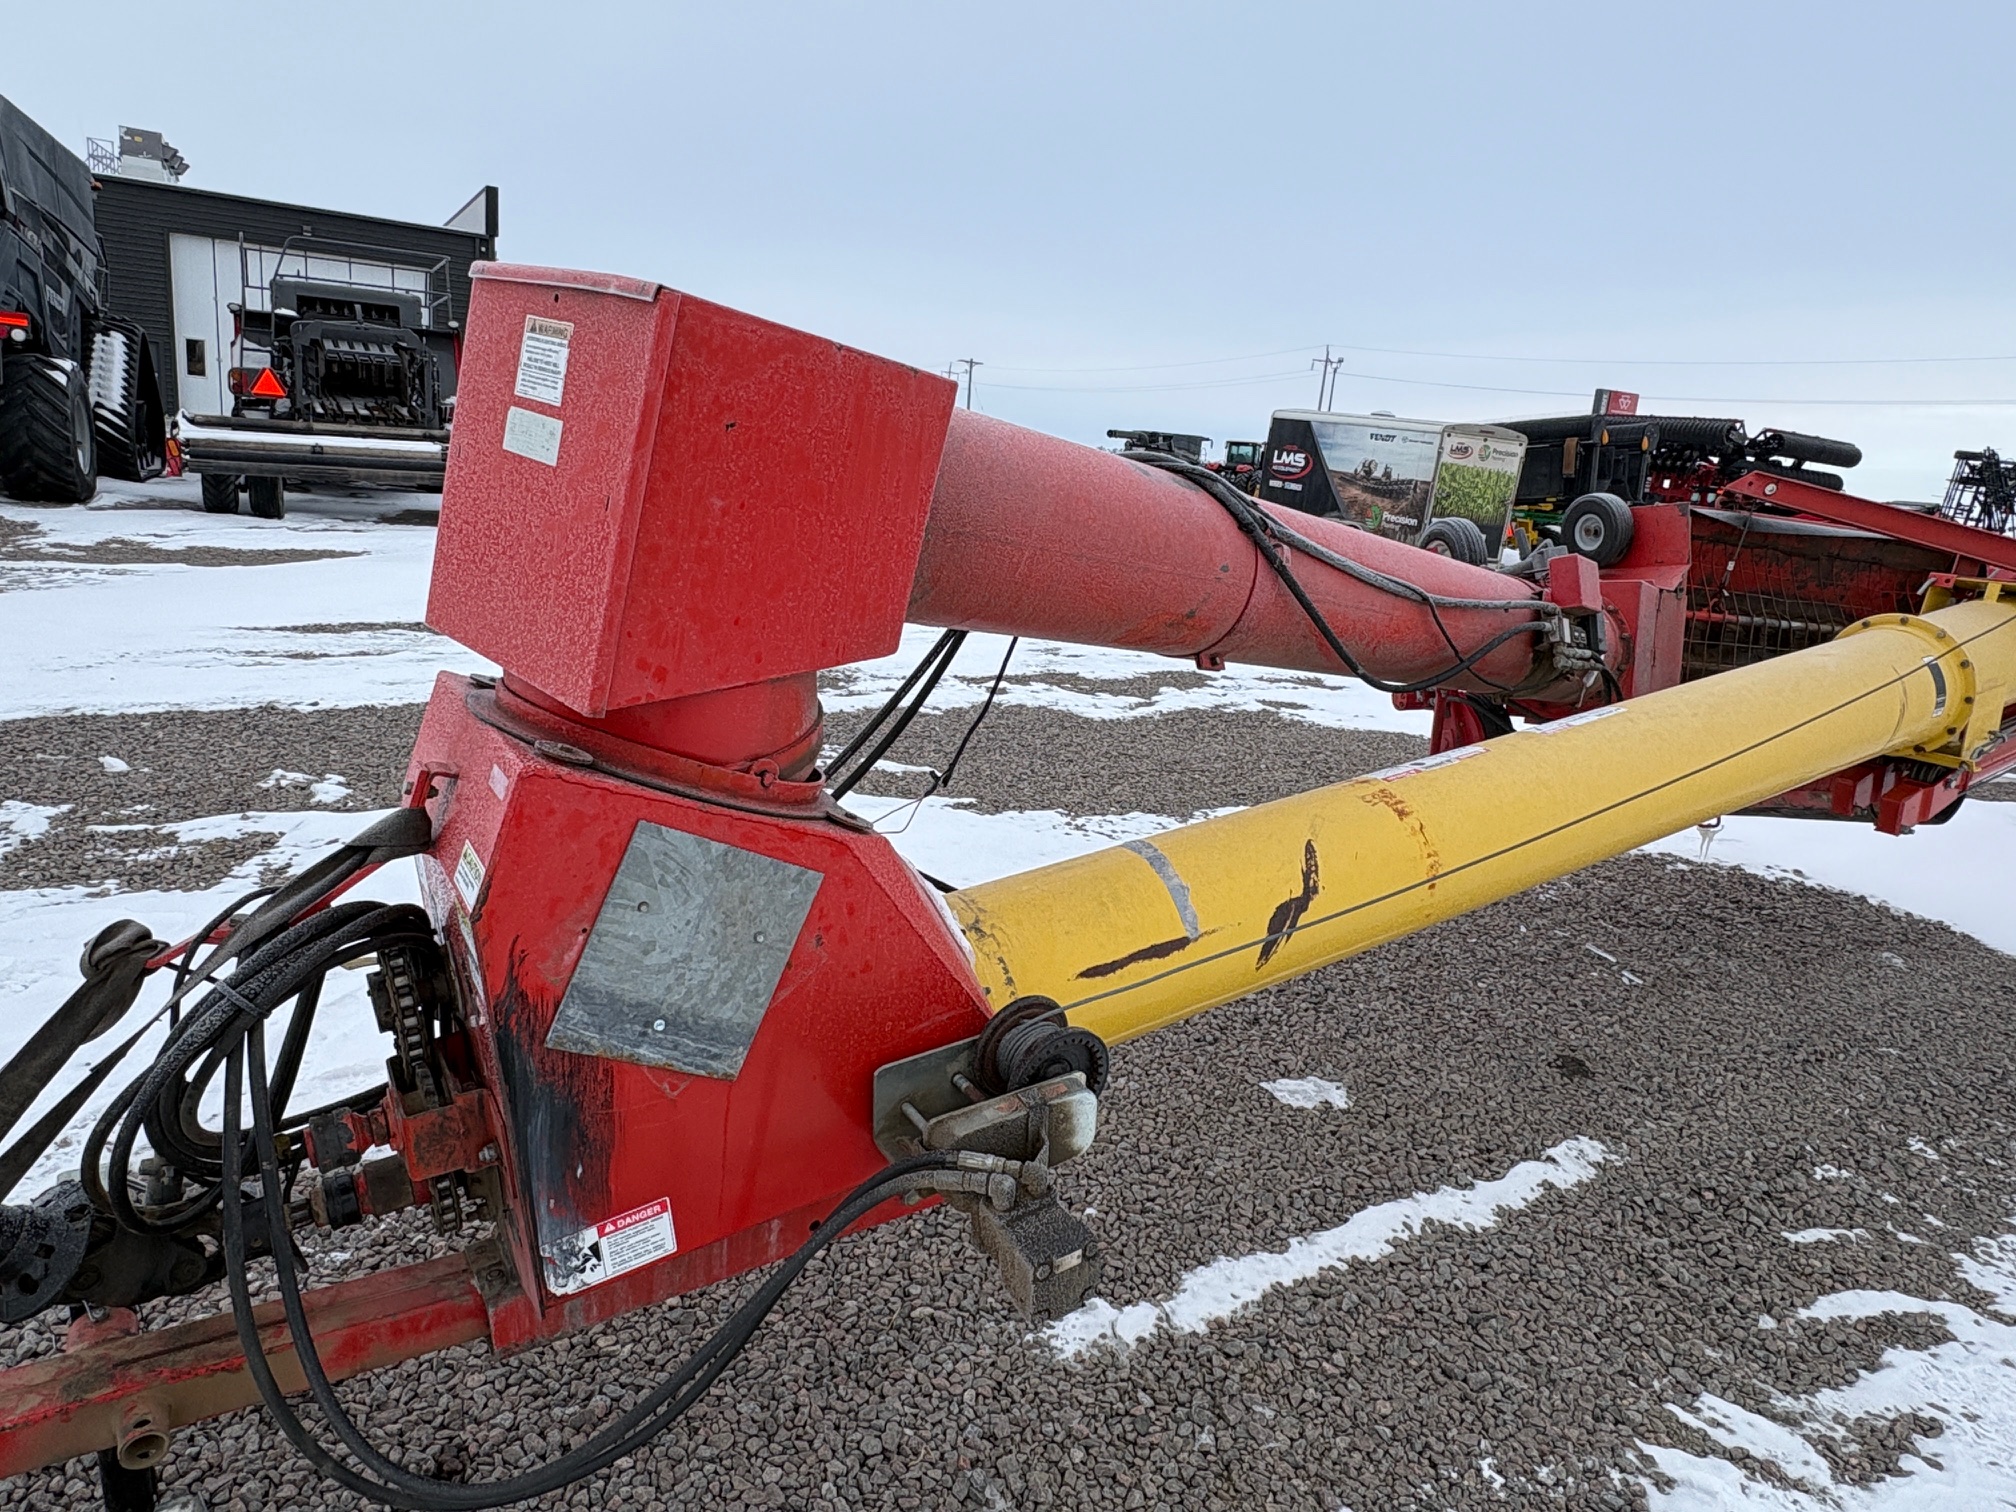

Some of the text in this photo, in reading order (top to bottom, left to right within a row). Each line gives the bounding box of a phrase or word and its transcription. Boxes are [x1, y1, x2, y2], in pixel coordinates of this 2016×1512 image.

[1369, 433, 1397, 442] FENDT
[1450, 443, 1470, 455] LMS
[1492, 448, 1518, 458] Precision
[1272, 449, 1306, 467] LMS
[1382, 511, 1418, 527] Precision
[616, 1204, 662, 1228] DANGER
